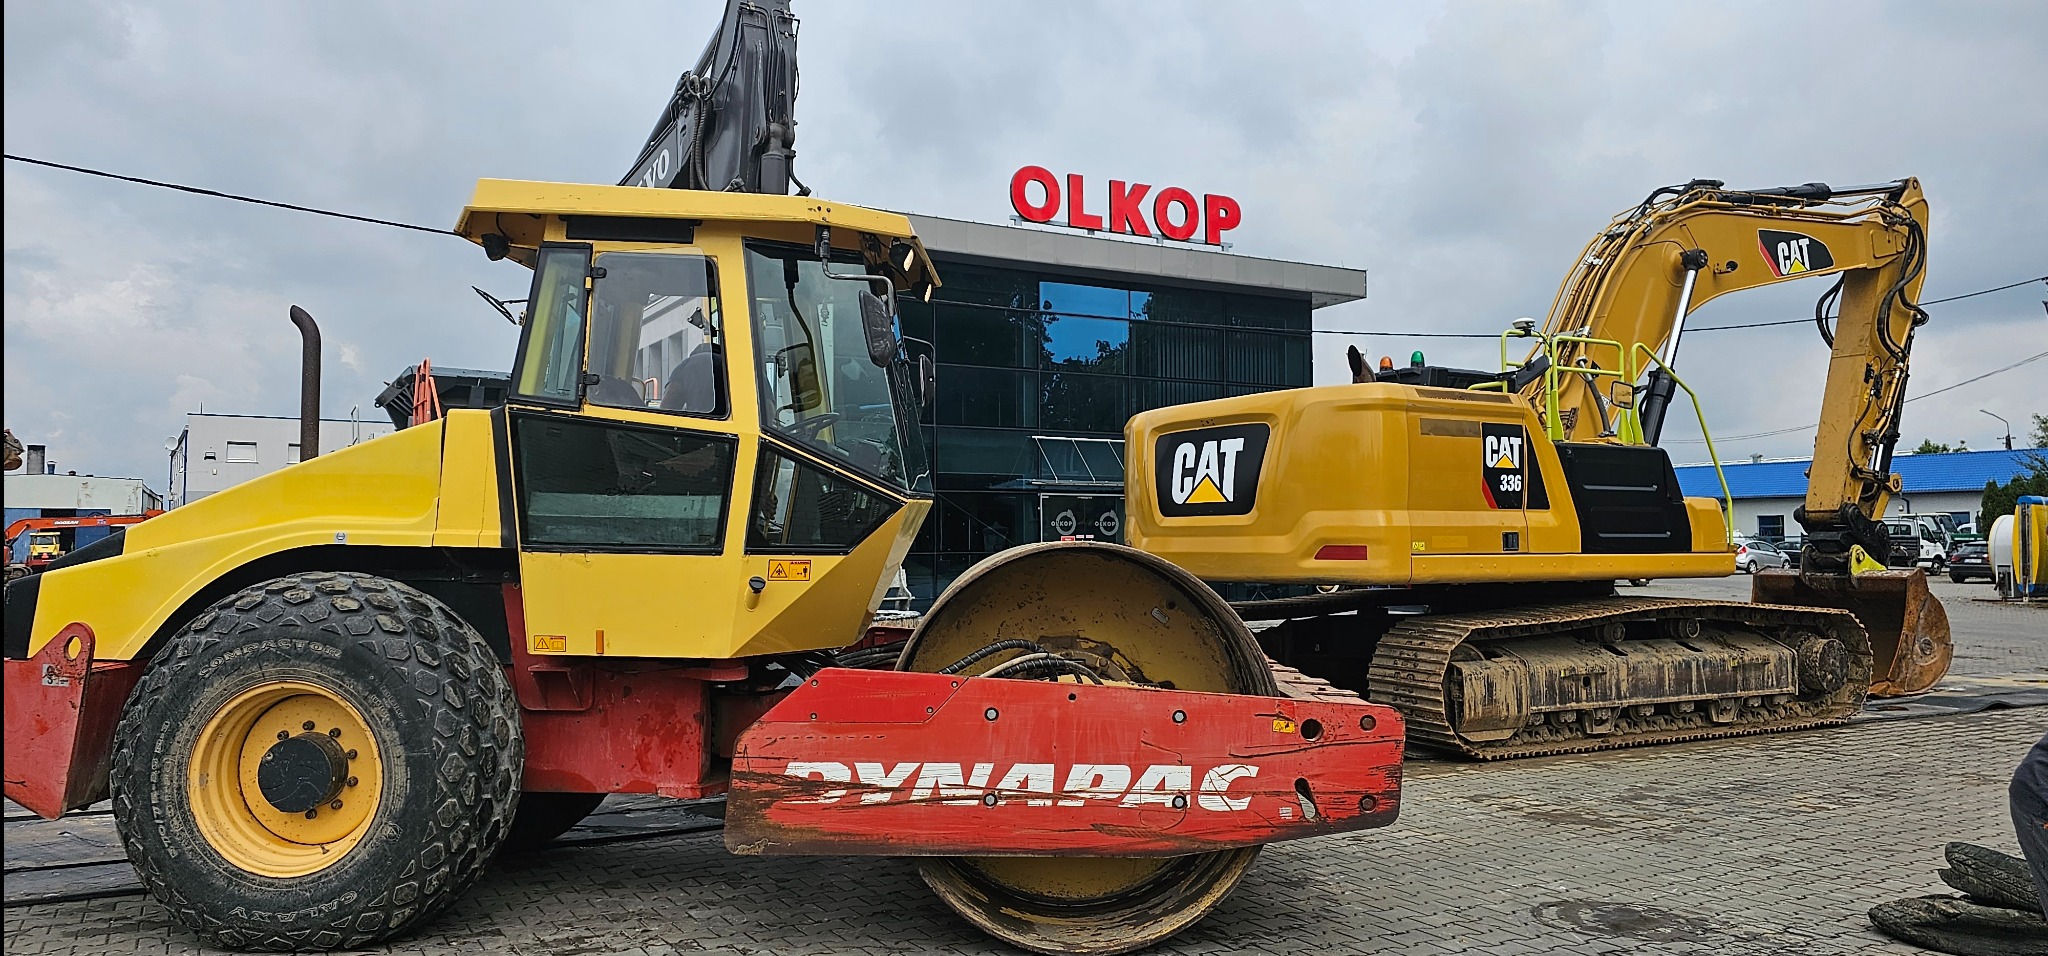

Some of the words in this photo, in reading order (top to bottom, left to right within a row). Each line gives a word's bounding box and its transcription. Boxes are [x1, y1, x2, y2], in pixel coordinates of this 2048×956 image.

[1010, 165, 1242, 245] OLKOP
[1777, 238, 1811, 275] CAT
[1171, 437, 1245, 505] CAT
[1485, 435, 1522, 469] CAT
[1500, 474, 1522, 492] 336
[199, 638, 342, 678] COMPACTOR
[782, 762, 1259, 812] DYNAPAC
[227, 890, 358, 923] GALAXY
